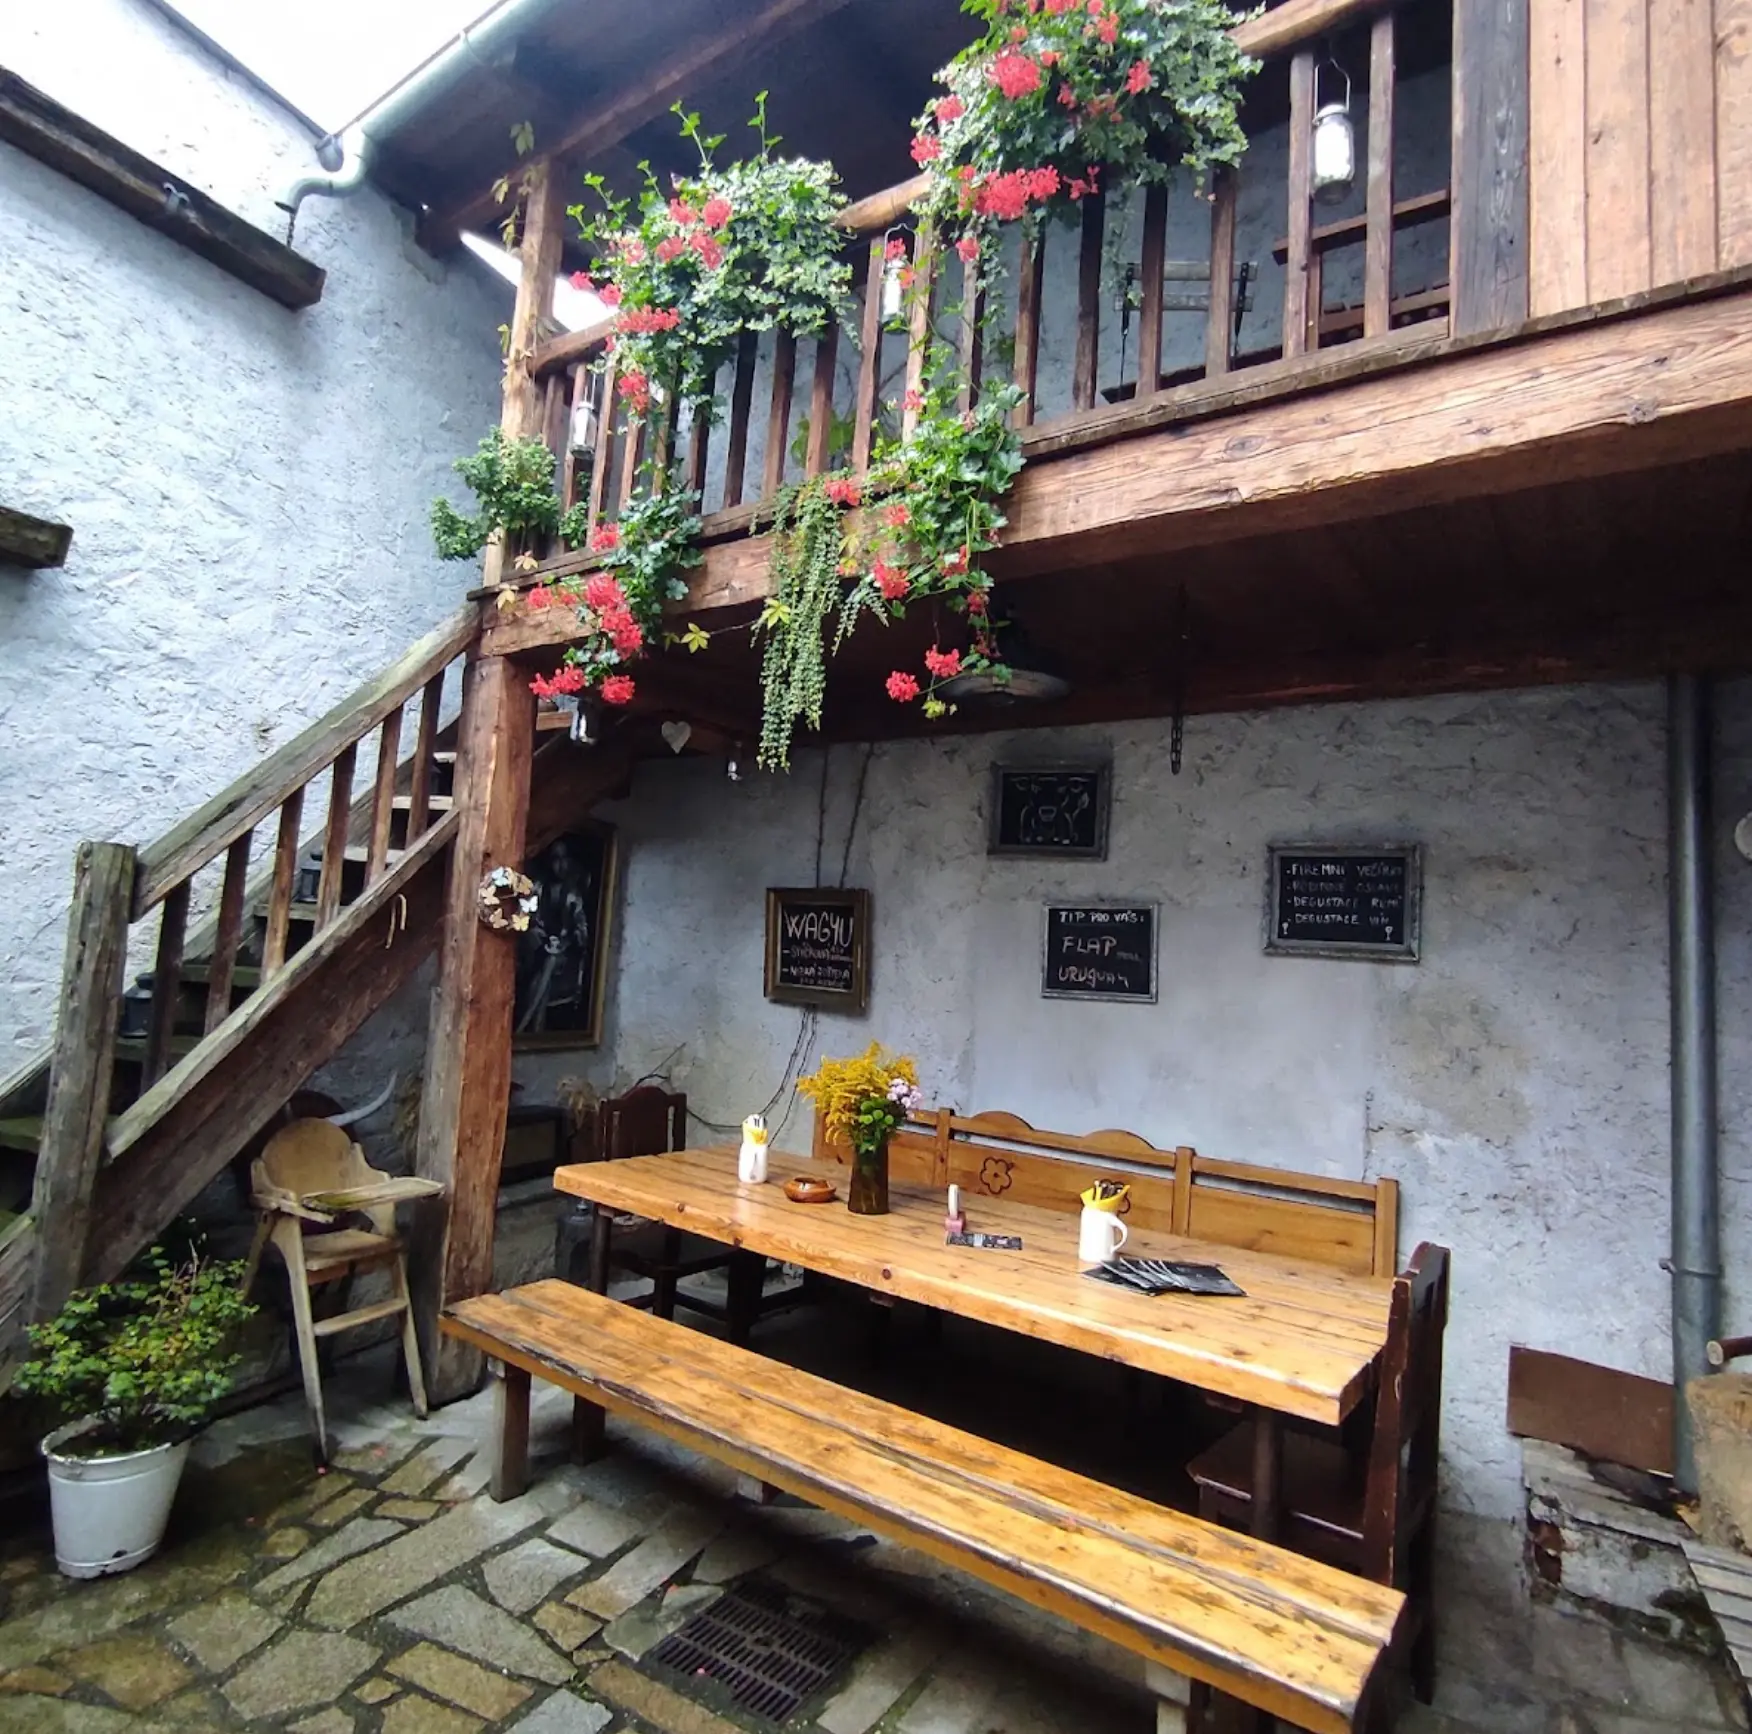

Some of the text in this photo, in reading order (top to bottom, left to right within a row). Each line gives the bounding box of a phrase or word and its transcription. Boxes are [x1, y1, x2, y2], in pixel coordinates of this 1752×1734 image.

[1059, 911, 1085, 923] TIP
[1089, 912, 1110, 923] PRO
[1295, 912, 1360, 925] DEGUSTACE
[783, 911, 854, 947] WAGYU
[1062, 935, 1117, 956] FLAP
